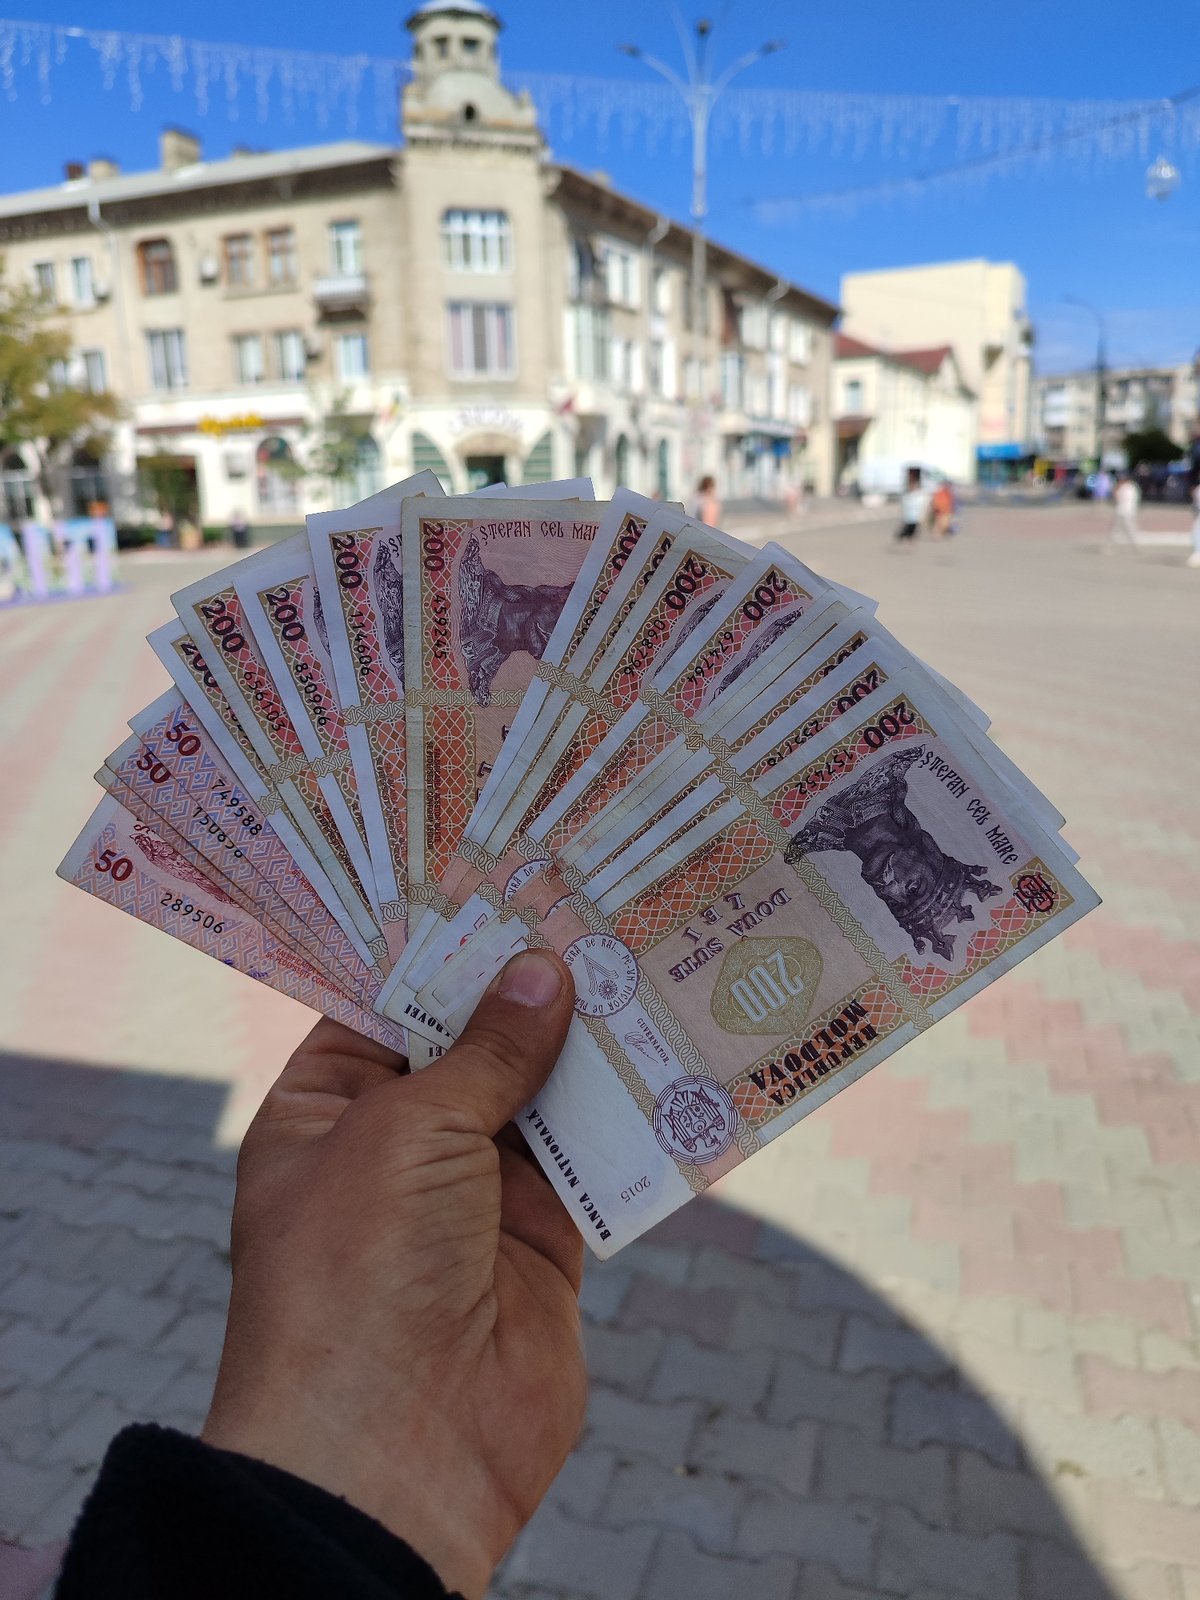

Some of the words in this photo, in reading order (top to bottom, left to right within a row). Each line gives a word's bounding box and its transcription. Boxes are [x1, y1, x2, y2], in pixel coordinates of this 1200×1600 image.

[423, 522, 445, 572] 200
[540, 521, 564, 538] CEL
[332, 534, 363, 588] 200
[665, 558, 706, 610] 200
[266, 587, 305, 642] 200
[743, 570, 787, 620] 200
[200, 600, 245, 652] 200
[350, 612, 374, 676] 114606
[433, 594, 448, 660] 459245
[624, 619, 666, 676] 068796
[688, 632, 734, 685] 674764
[244, 672, 286, 731] 656103
[295, 662, 331, 726] 830966
[166, 722, 200, 756] 50
[863, 702, 914, 748] 200
[136, 750, 172, 784] 50
[794, 749, 853, 795] 157452
[211, 778, 262, 836] 749588
[966, 798, 990, 826] CEL
[94, 850, 133, 882] 50
[160, 893, 225, 934] 289506
[668, 937, 724, 983] SUTE
[729, 950, 806, 1024] 200
[748, 998, 868, 1091] MOLDOVA
[769, 1024, 879, 1106] REPUBLICA
[620, 1176, 651, 1204] 2015
[578, 1192, 612, 1242] BANCA
